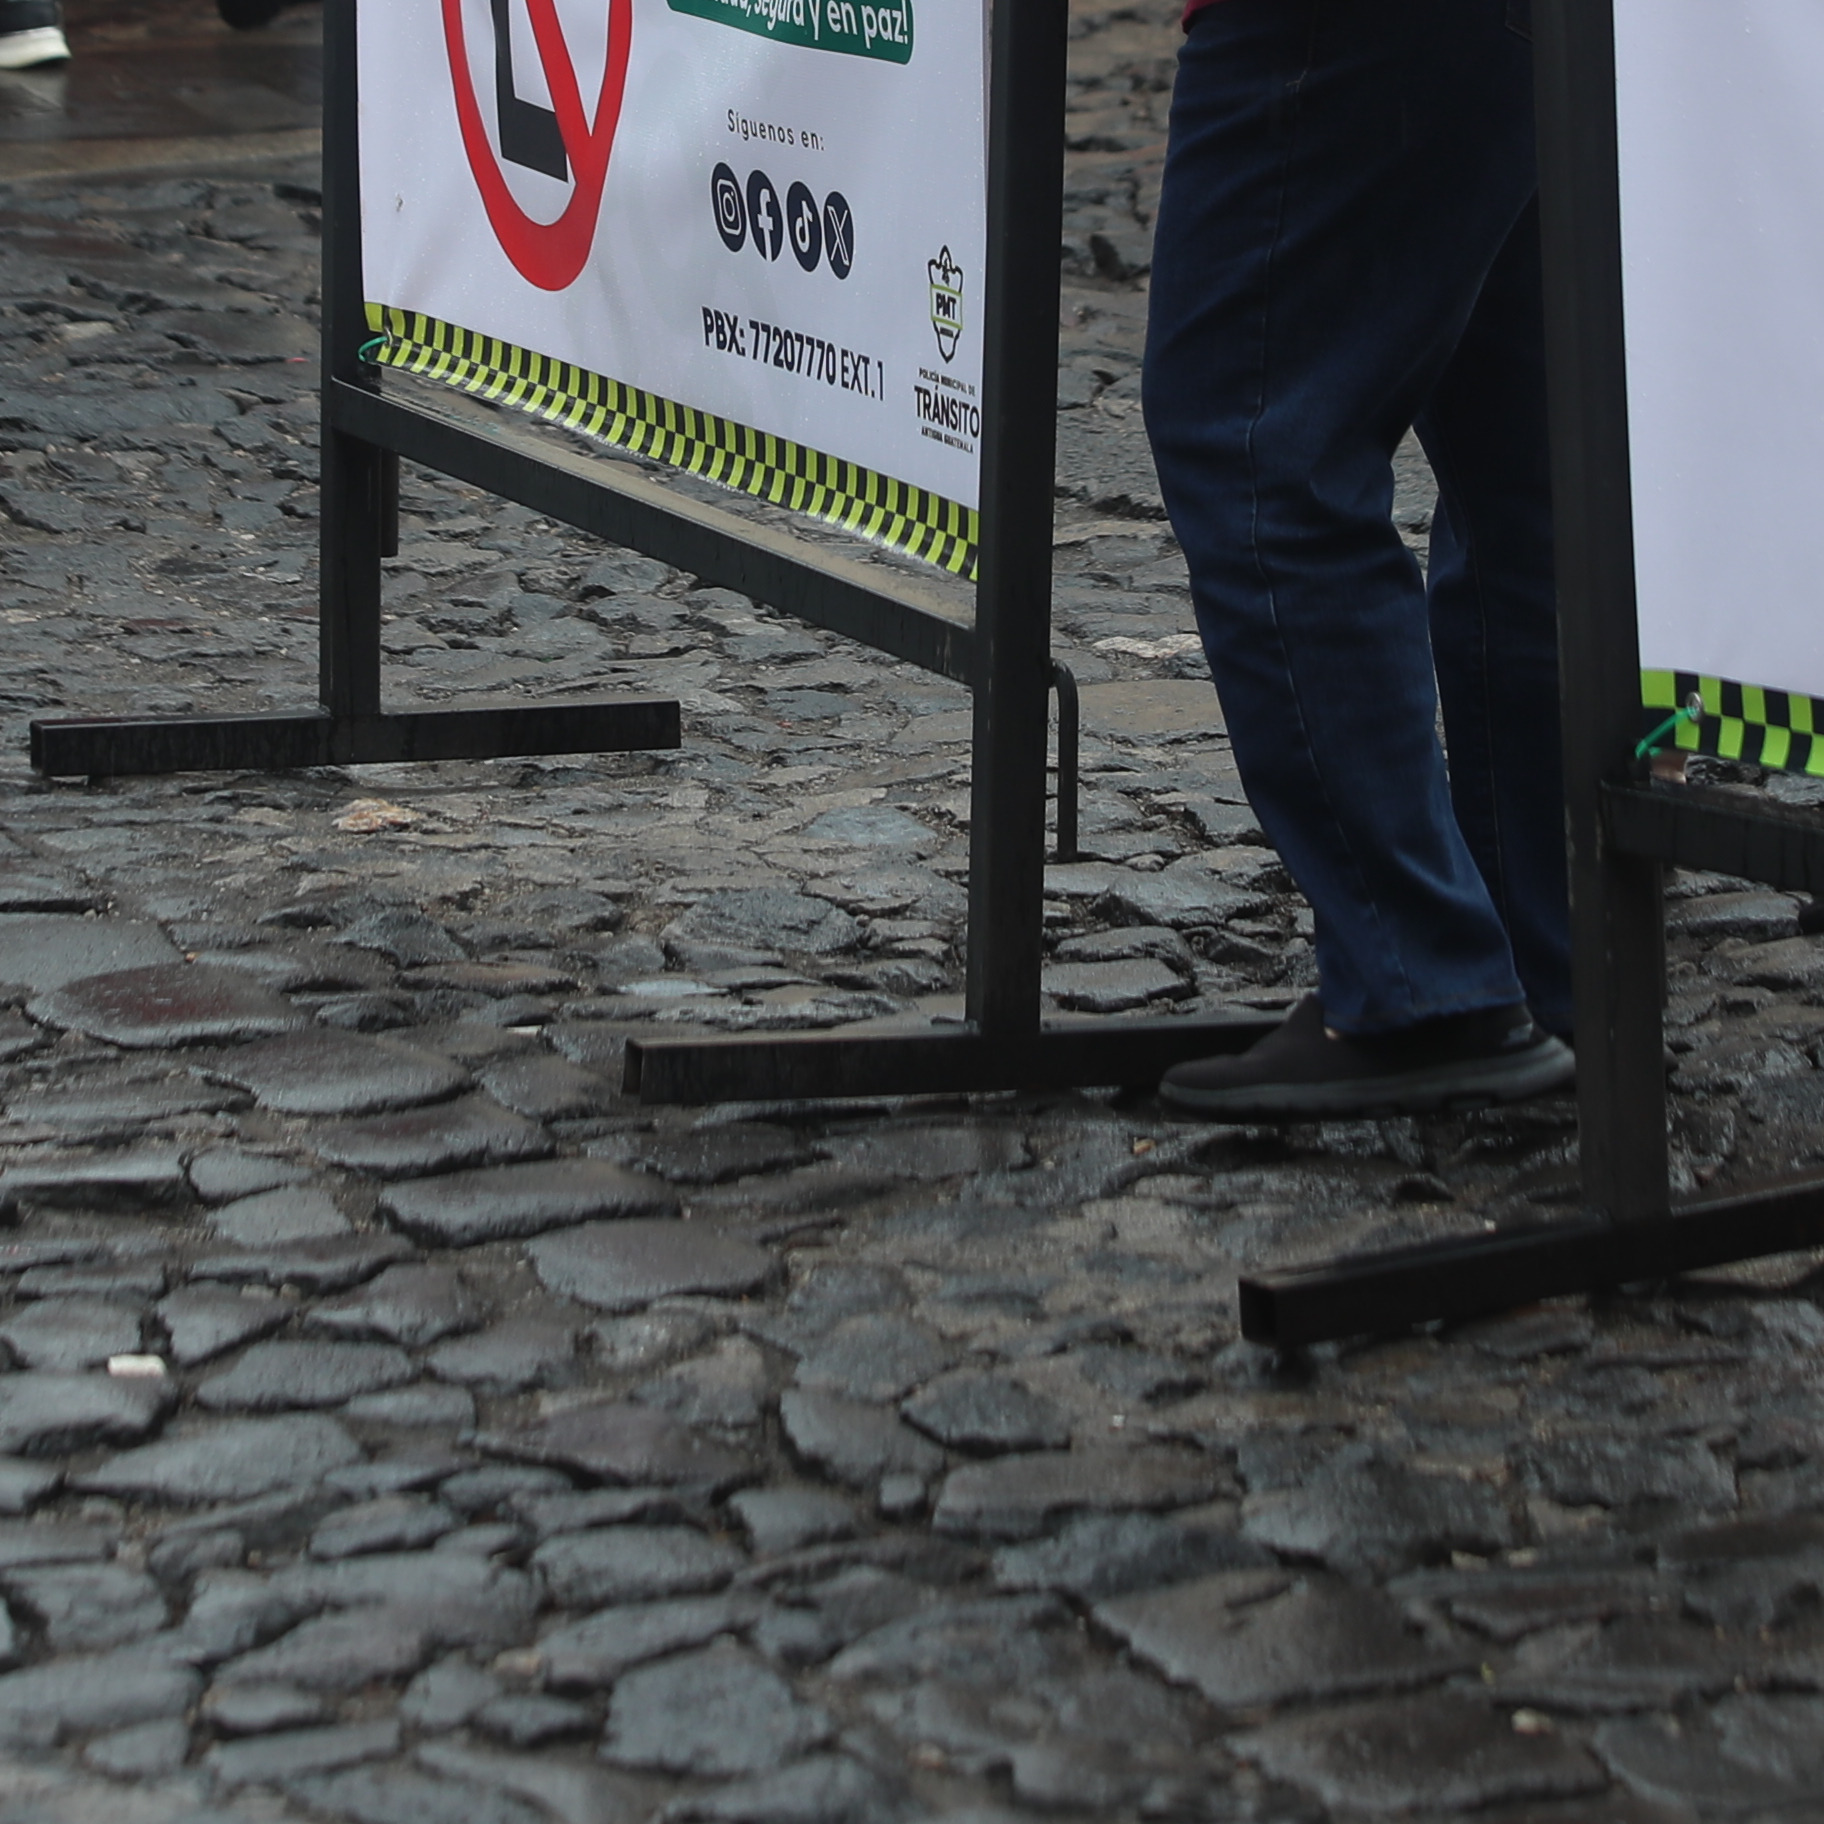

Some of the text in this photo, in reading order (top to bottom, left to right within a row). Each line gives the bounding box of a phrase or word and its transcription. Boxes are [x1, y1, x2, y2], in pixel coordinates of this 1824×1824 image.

[826, 0, 858, 36] en
[801, 130, 825, 151] en:
[936, 292, 957, 320] PMT
[701, 305, 746, 358] PBX:
[748, 318, 837, 387] 77207770
[913, 384, 980, 438] TRÁNSITO
